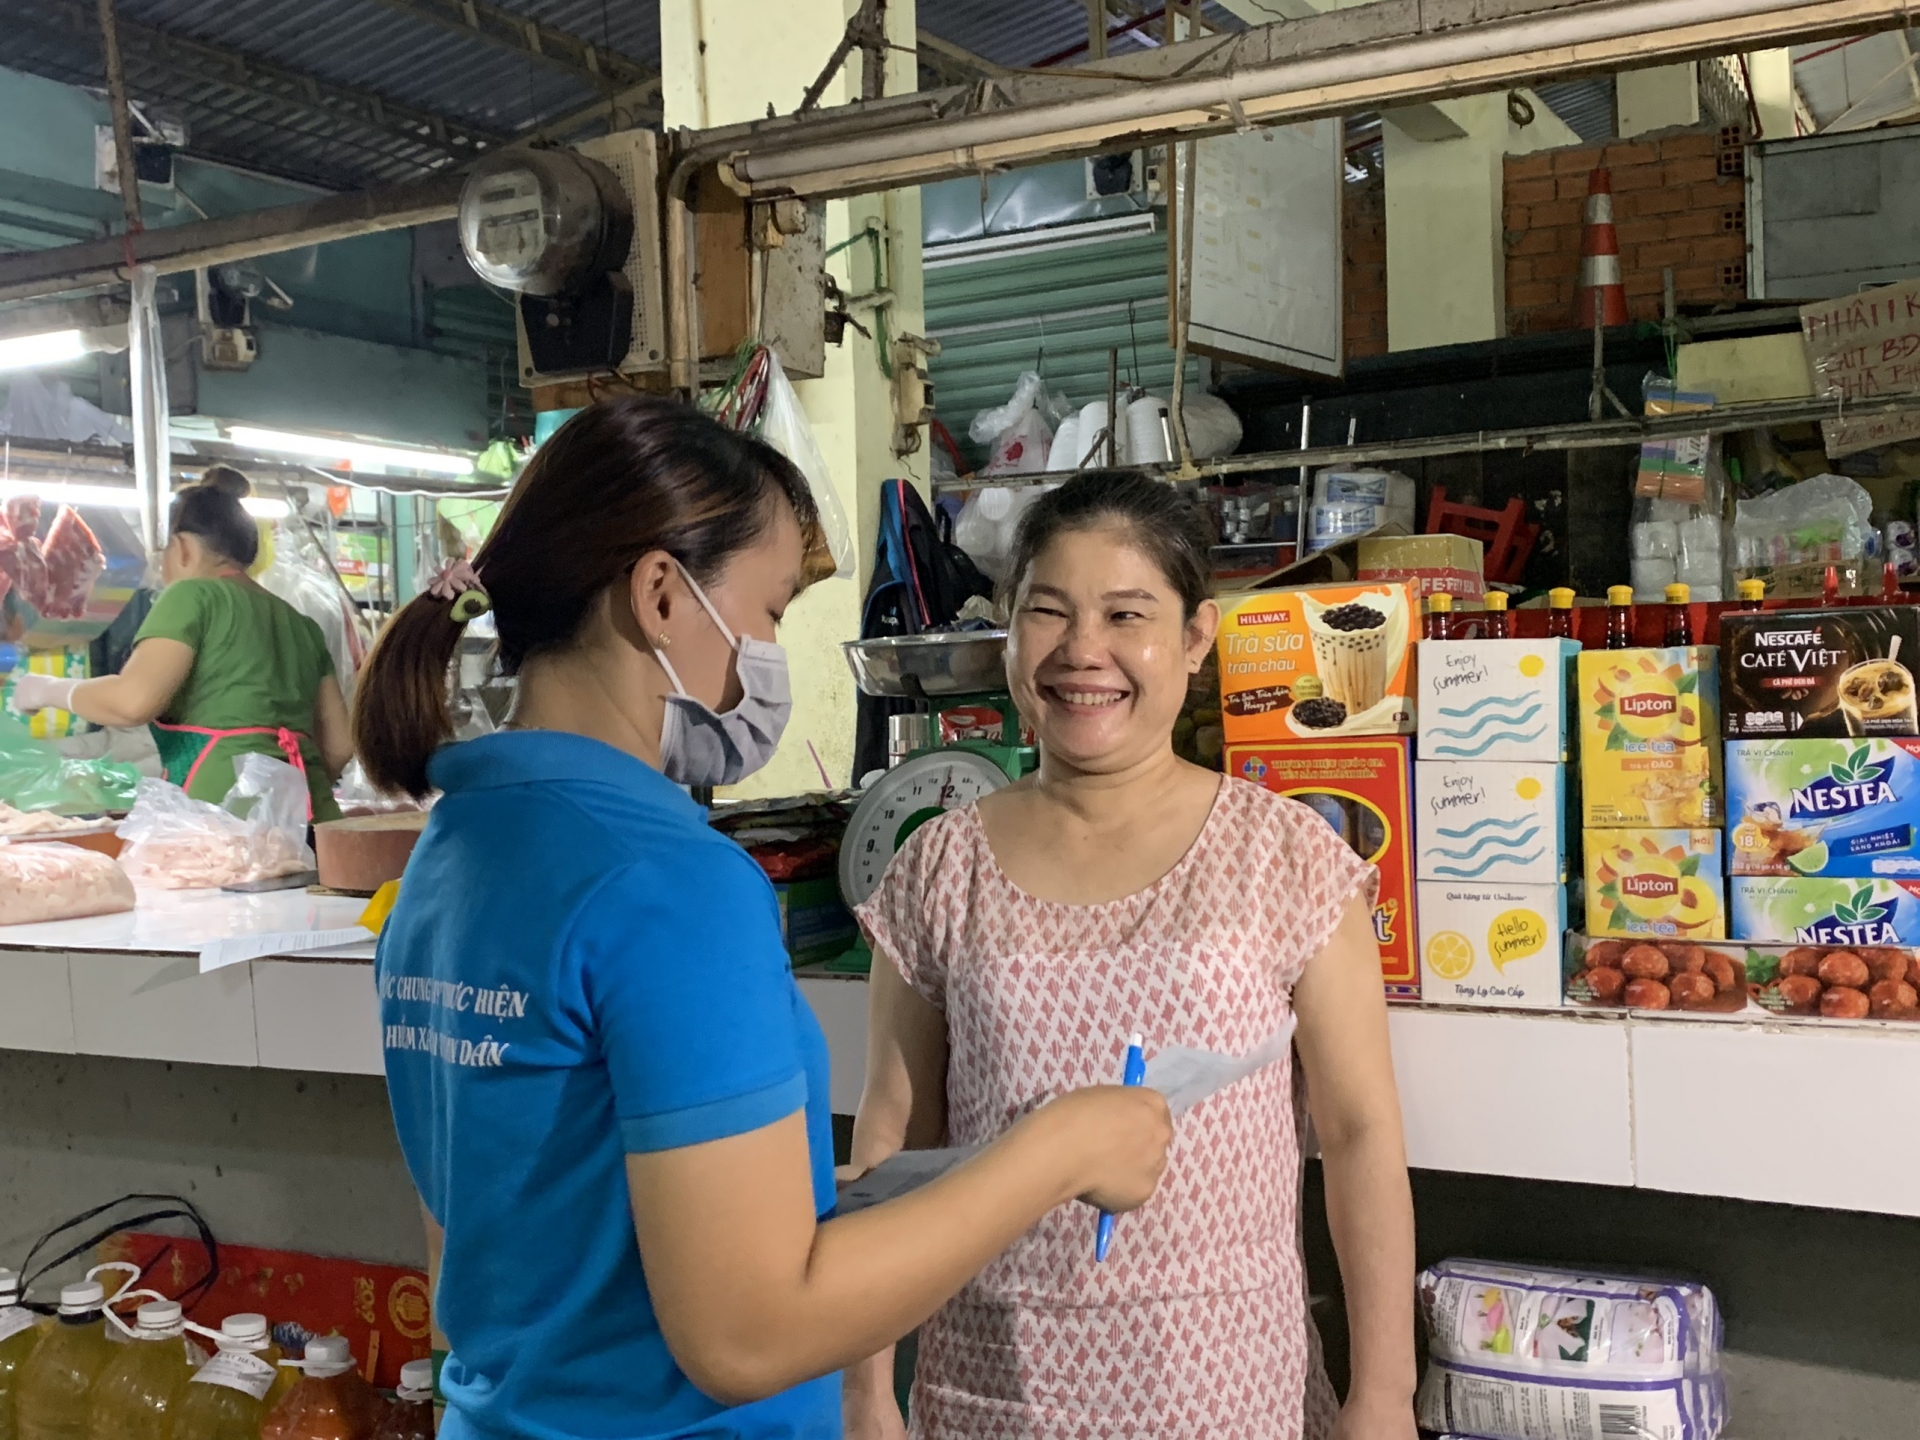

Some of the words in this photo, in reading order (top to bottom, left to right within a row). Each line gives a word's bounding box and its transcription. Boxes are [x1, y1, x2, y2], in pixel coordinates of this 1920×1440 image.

[1224, 632, 1259, 656] Trà
[1263, 629, 1304, 653] sữa
[1755, 626, 1823, 647] NESCAFÉ
[1227, 659, 1257, 675] trân
[1260, 657, 1297, 673] châu
[1445, 650, 1476, 670] Enjoy
[1740, 650, 1786, 668] CAFÉ
[1788, 649, 1842, 673] VIỆT
[1624, 698, 1672, 714] Lipton
[1624, 740, 1647, 753] ice
[1651, 741, 1675, 753] tea
[1443, 772, 1473, 792] Enjoy
[1791, 782, 1897, 813] NESTEA
[866, 839, 875, 853] 9
[1738, 835, 1754, 846] 18
[1626, 879, 1674, 893] Lipton
[1497, 916, 1529, 937] Hello
[1626, 919, 1649, 933] ice
[1652, 921, 1676, 933] tea
[1796, 922, 1900, 944] NESTEA
[474, 983, 529, 1023] HIỆN
[459, 1034, 510, 1068] DÂN
